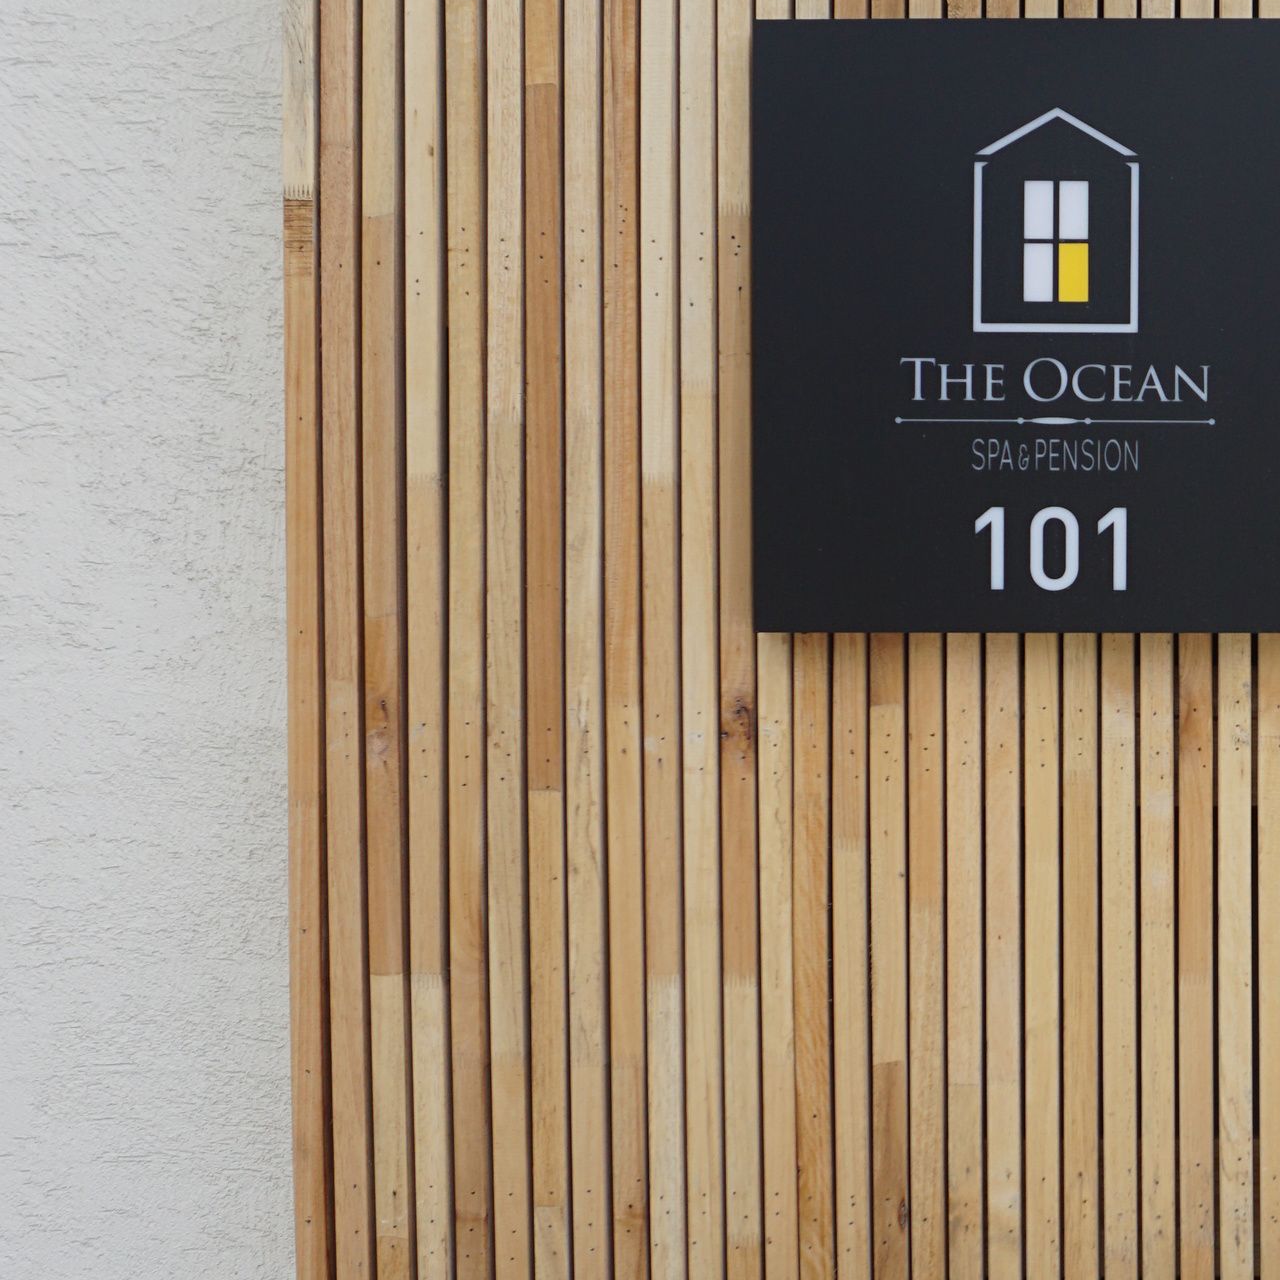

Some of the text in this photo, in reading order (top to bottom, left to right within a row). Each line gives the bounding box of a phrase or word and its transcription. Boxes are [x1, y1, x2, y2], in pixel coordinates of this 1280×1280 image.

[899, 357, 1211, 403] THE OCEAN
[974, 506, 1127, 592] 101
